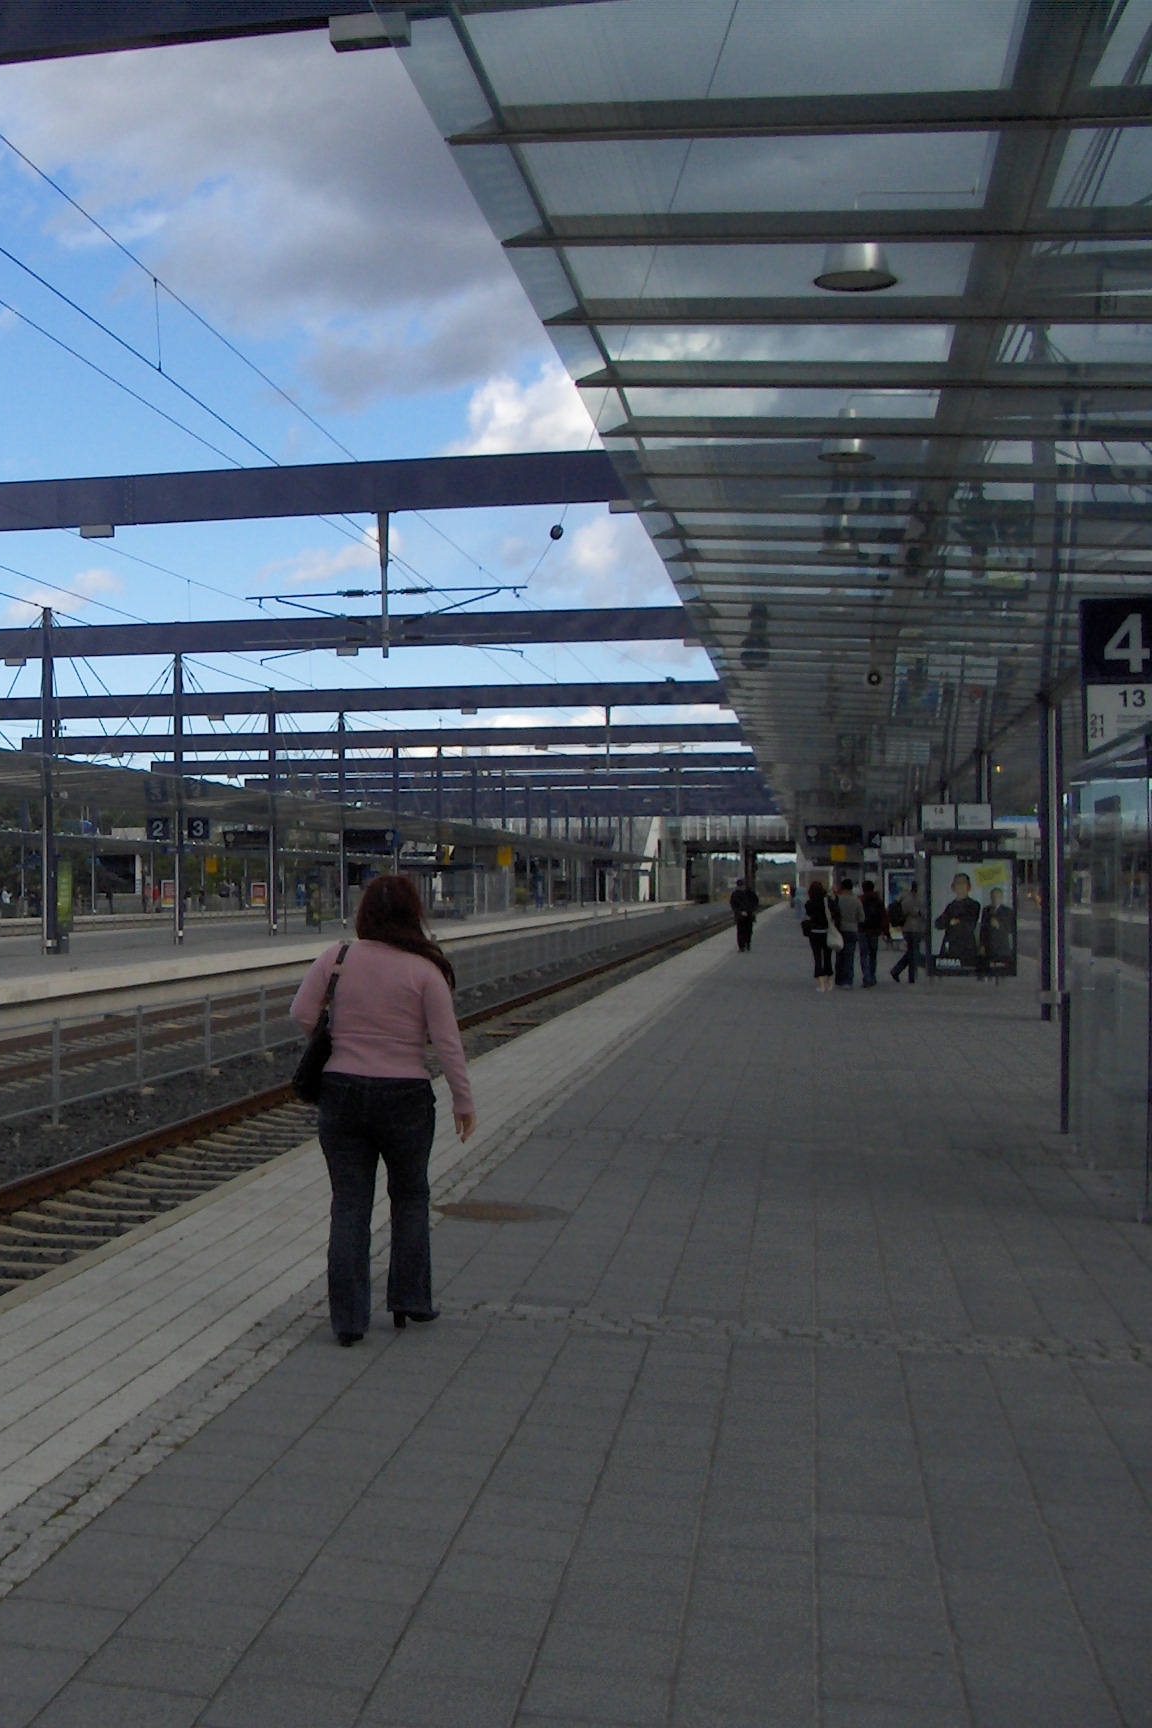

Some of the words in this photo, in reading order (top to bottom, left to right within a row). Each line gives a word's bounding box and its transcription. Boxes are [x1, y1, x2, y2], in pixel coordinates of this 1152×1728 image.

[1103, 612, 1151, 674] 4
[1118, 688, 1146, 708] 13
[151, 820, 164, 837] 2
[192, 820, 204, 837] 3
